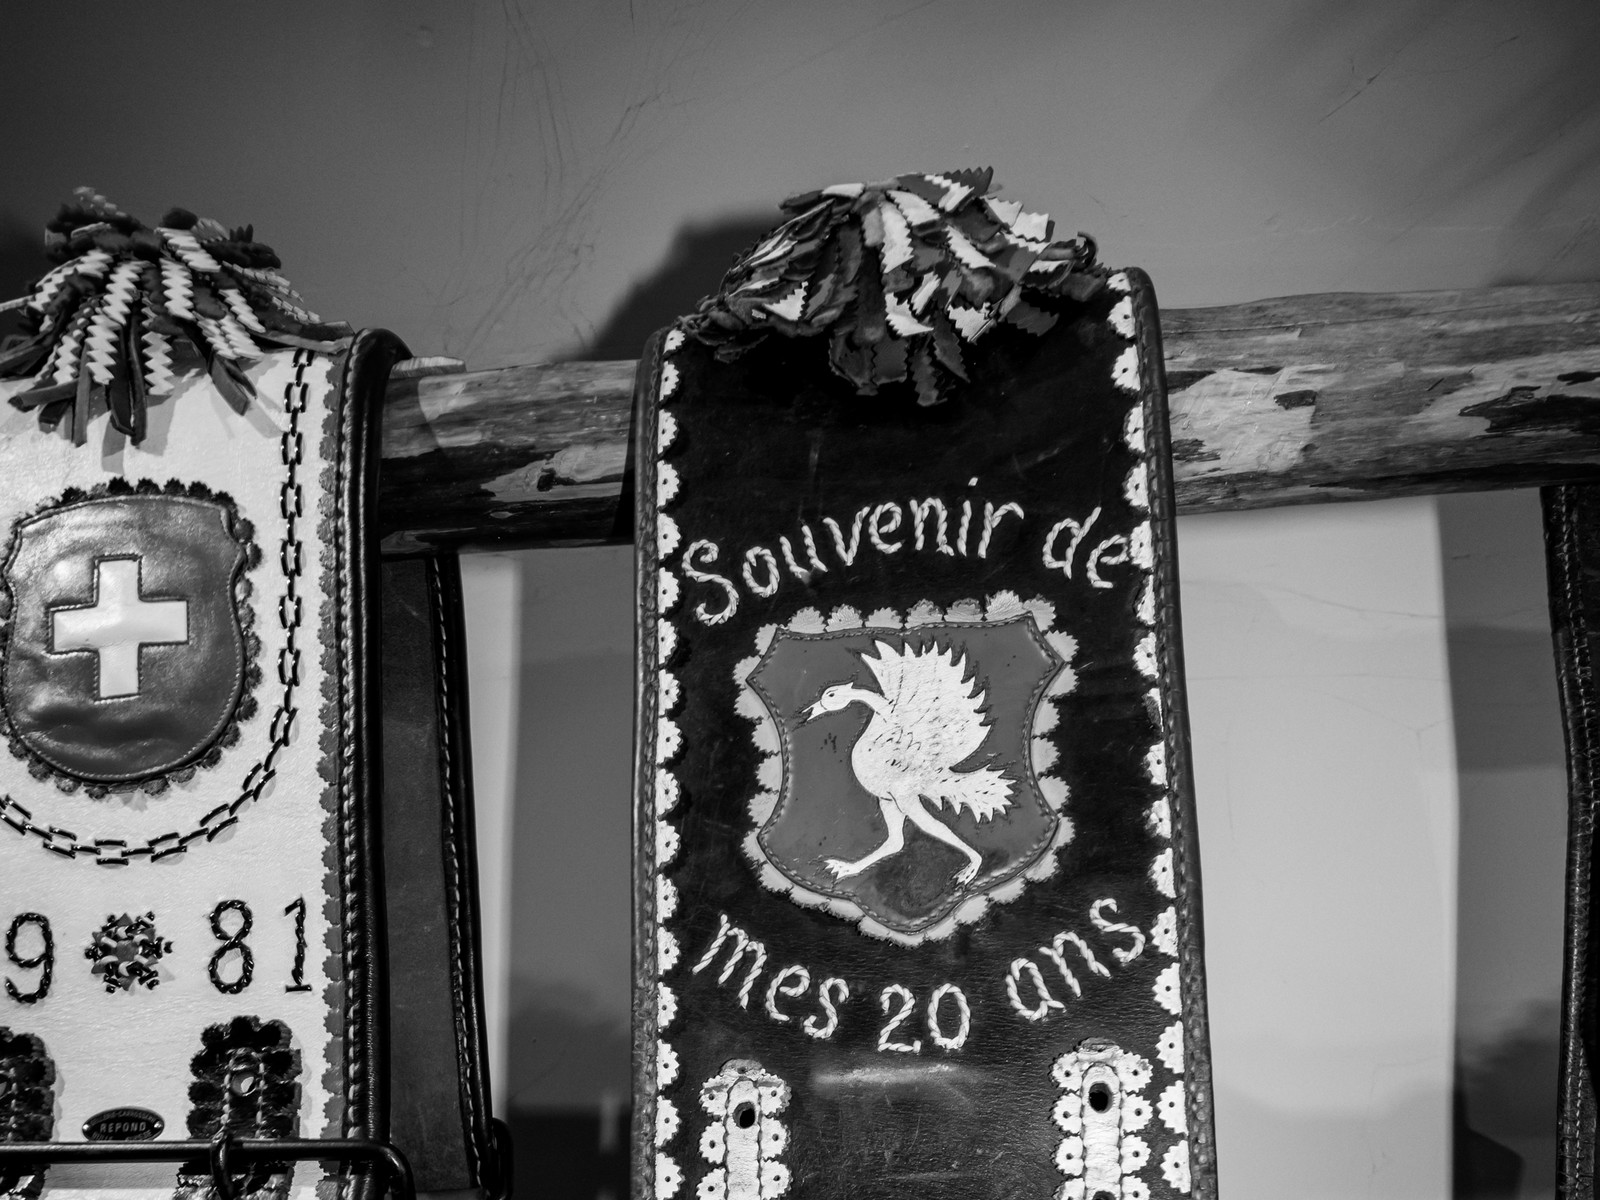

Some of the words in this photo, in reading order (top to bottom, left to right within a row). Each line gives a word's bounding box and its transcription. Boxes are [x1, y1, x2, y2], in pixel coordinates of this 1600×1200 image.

[681, 476, 1024, 626] Souvenir
[1041, 506, 1131, 589] de
[208, 896, 312, 994] 81
[878, 983, 972, 1053] 20
[1006, 898, 1146, 1022] ans
